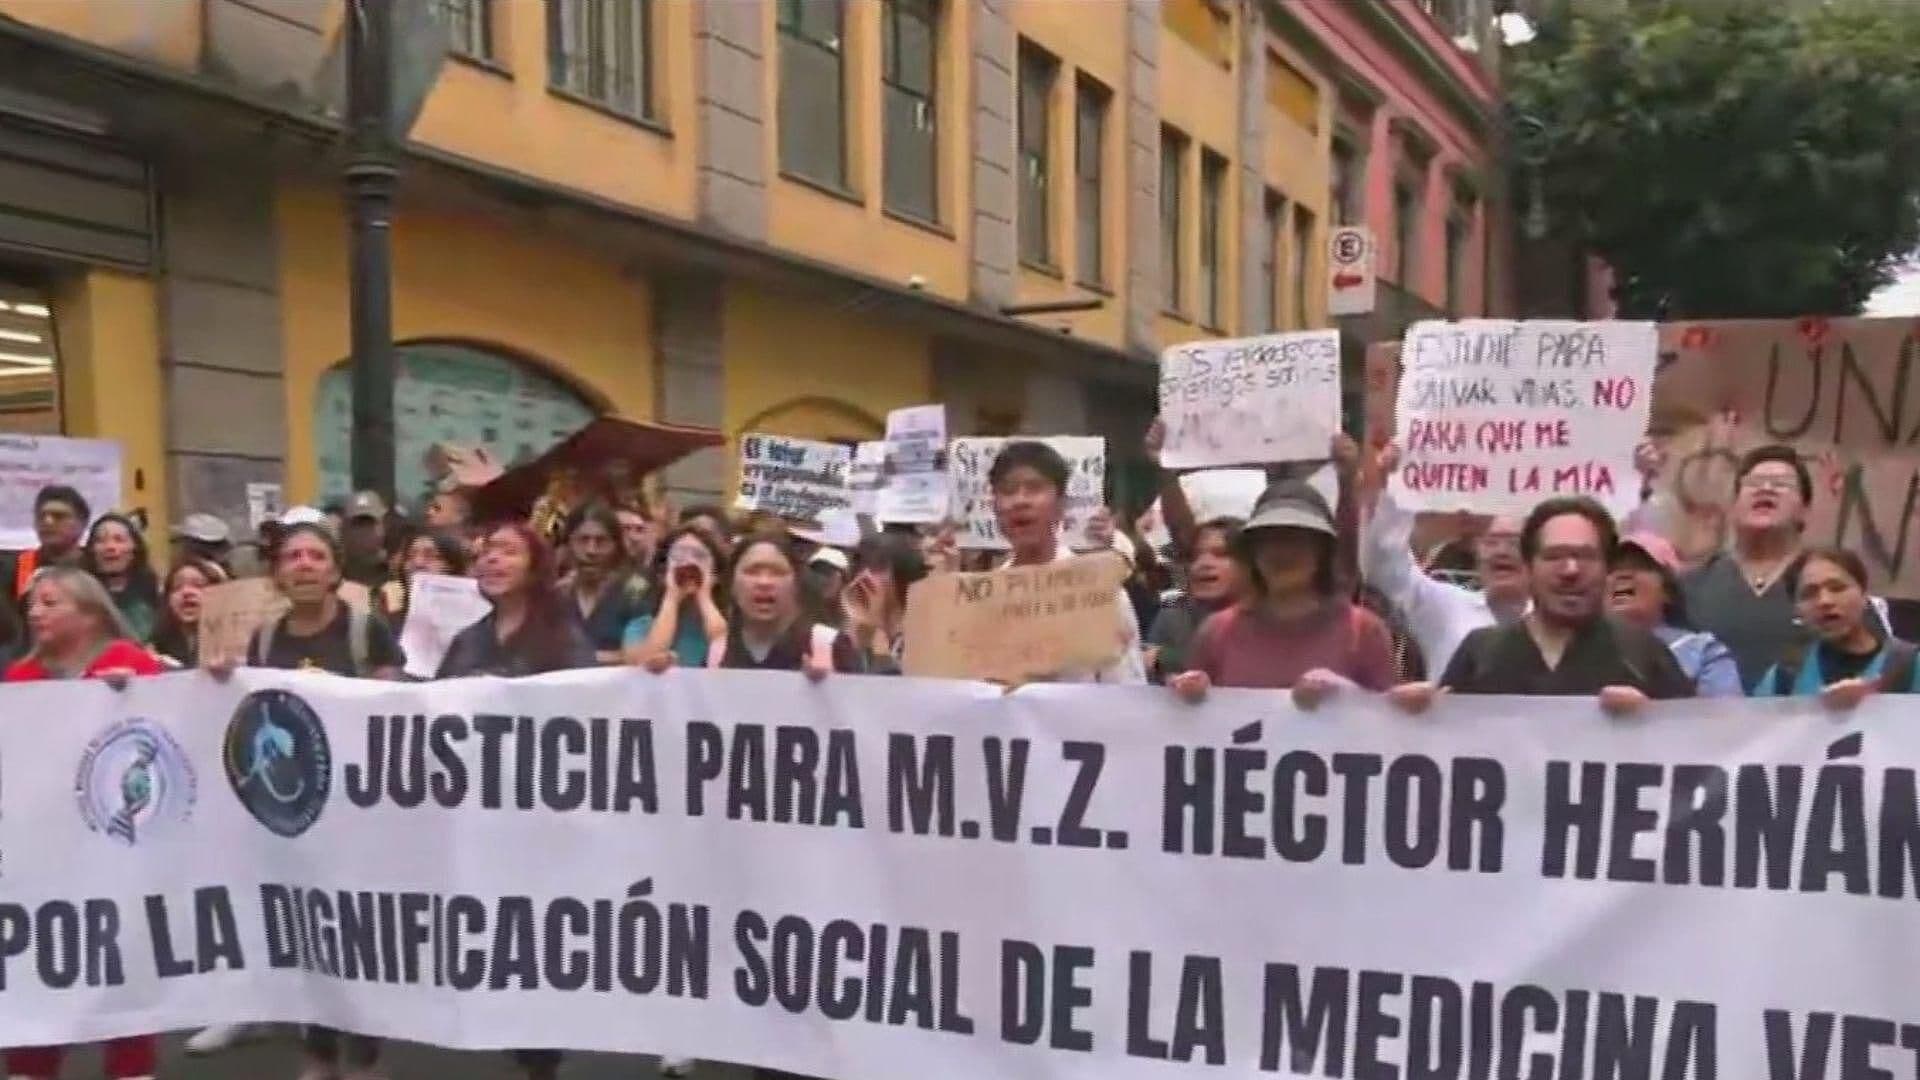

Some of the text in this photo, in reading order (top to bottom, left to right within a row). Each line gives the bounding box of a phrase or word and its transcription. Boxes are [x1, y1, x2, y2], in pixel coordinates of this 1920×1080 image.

[1538, 332, 1605, 368] PARA
[1593, 376, 1636, 409] NO
[1765, 334, 1920, 445] UN
[1407, 418, 1570, 453] PARA QUE ME
[1402, 460, 1615, 494] QUITEN LA MÍA
[345, 715, 658, 814] JUSTICIA
[686, 722, 865, 828] PARA
[888, 733, 1128, 849] M.V.Z.
[1162, 720, 1506, 873] HÉCTOR
[0, 898, 124, 991] POR
[145, 886, 244, 978] LA
[259, 877, 709, 999] DIGNIFICACIÓN
[734, 910, 974, 1035] SOCIAL
[1001, 939, 1094, 1052] DE
[1127, 951, 1226, 1066] LA
[1260, 963, 1717, 1080] MEDICINA
